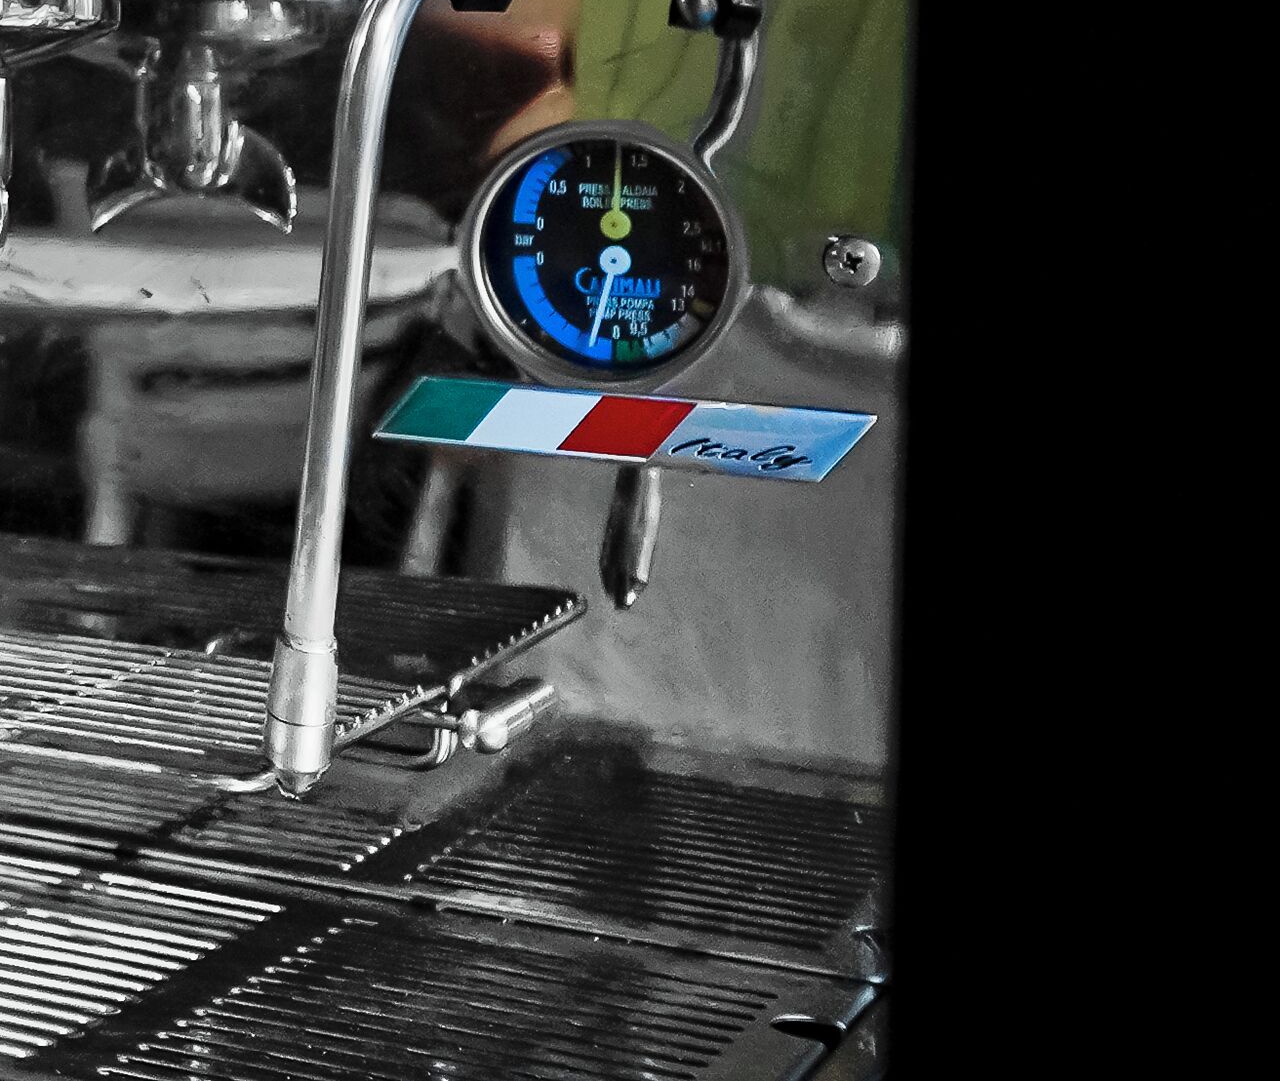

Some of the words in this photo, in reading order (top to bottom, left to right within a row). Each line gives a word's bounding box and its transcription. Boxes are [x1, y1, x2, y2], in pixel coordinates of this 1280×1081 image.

[536, 217, 544, 231] 0
[536, 252, 544, 266] 0
[668, 437, 813, 471] Italy
